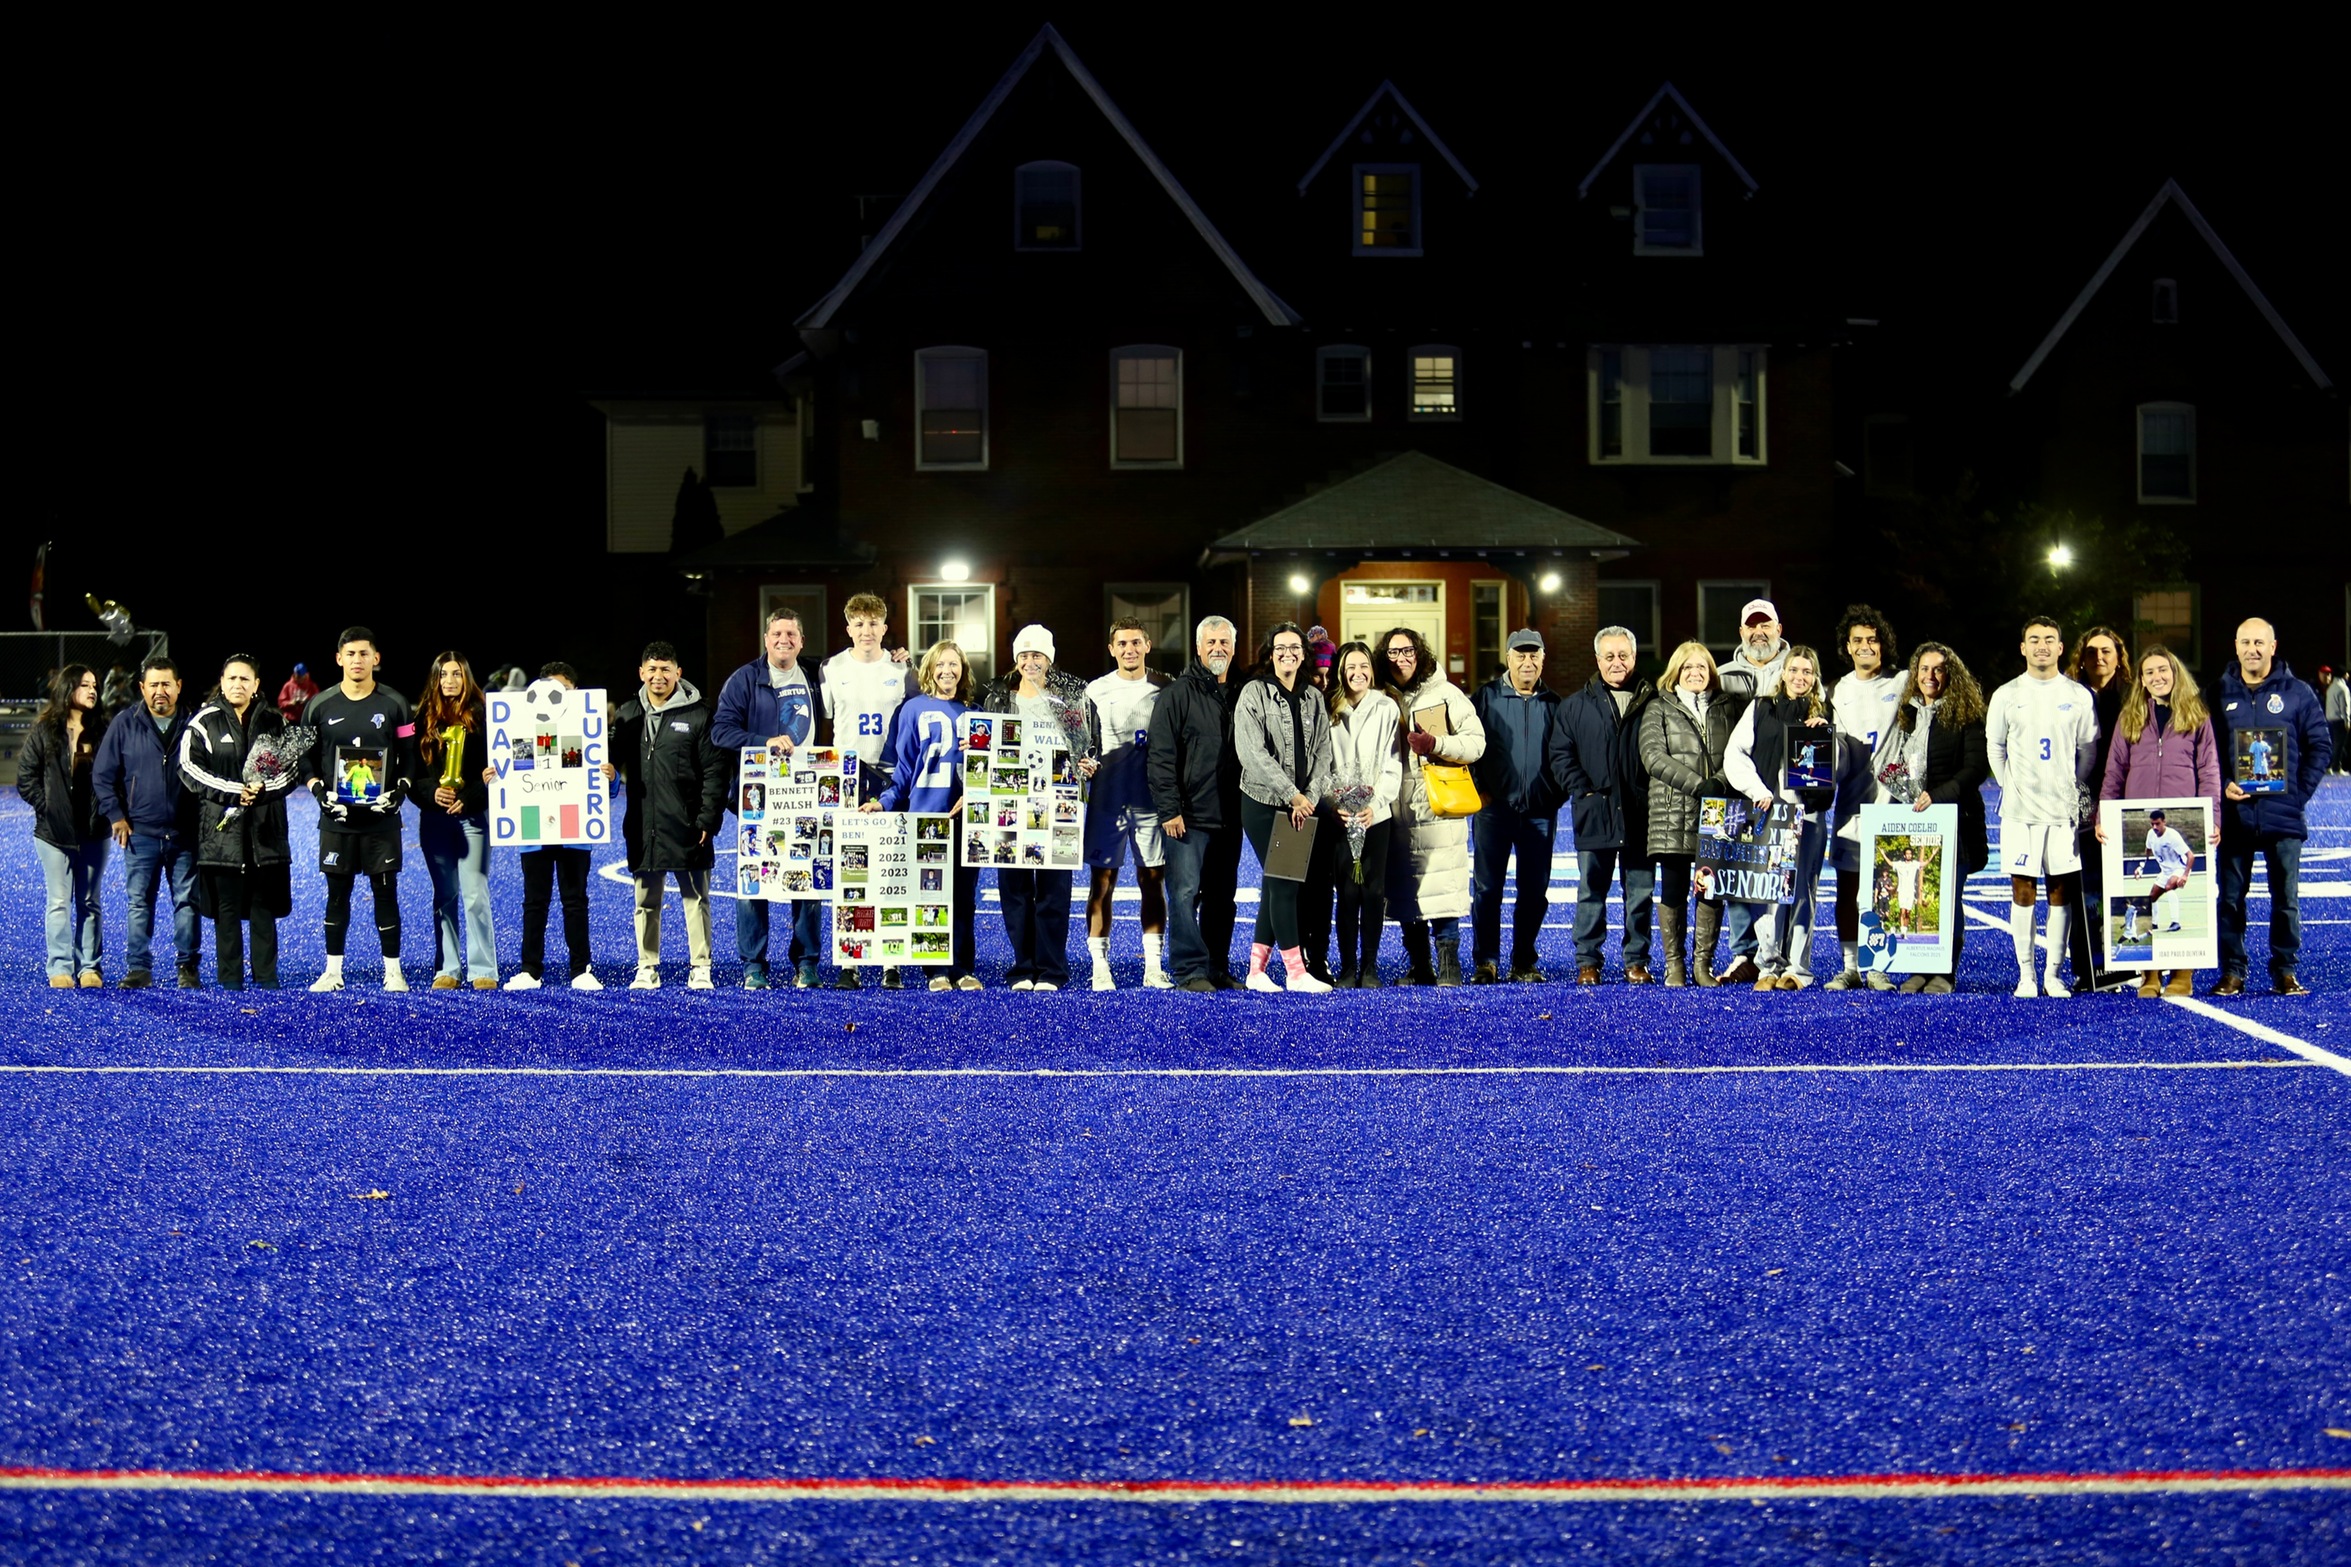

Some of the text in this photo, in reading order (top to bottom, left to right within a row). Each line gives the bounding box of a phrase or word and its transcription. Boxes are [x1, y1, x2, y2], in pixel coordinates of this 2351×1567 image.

[858, 713, 883, 735] 23
[1867, 731, 1878, 753] 7
[2040, 738, 2051, 760] 3
[537, 758, 552, 769] #1
[583, 692, 605, 839] LUCERO
[492, 701, 515, 839] DAVID
[522, 774, 568, 793] Senior
[769, 786, 815, 795] BENNETT
[772, 801, 812, 810] WALSH
[772, 817, 791, 825] #23
[841, 818, 887, 826] LET'S GO
[1882, 823, 1937, 832] AIDEN COELHO
[879, 836, 906, 845] 2021
[1910, 835, 1942, 846] SENIOR
[879, 853, 906, 862] 2022
[881, 868, 908, 877] 2023
[1715, 868, 1785, 900] SENIOR!
[879, 887, 906, 895] 2025
[1869, 933, 1886, 947] #7
